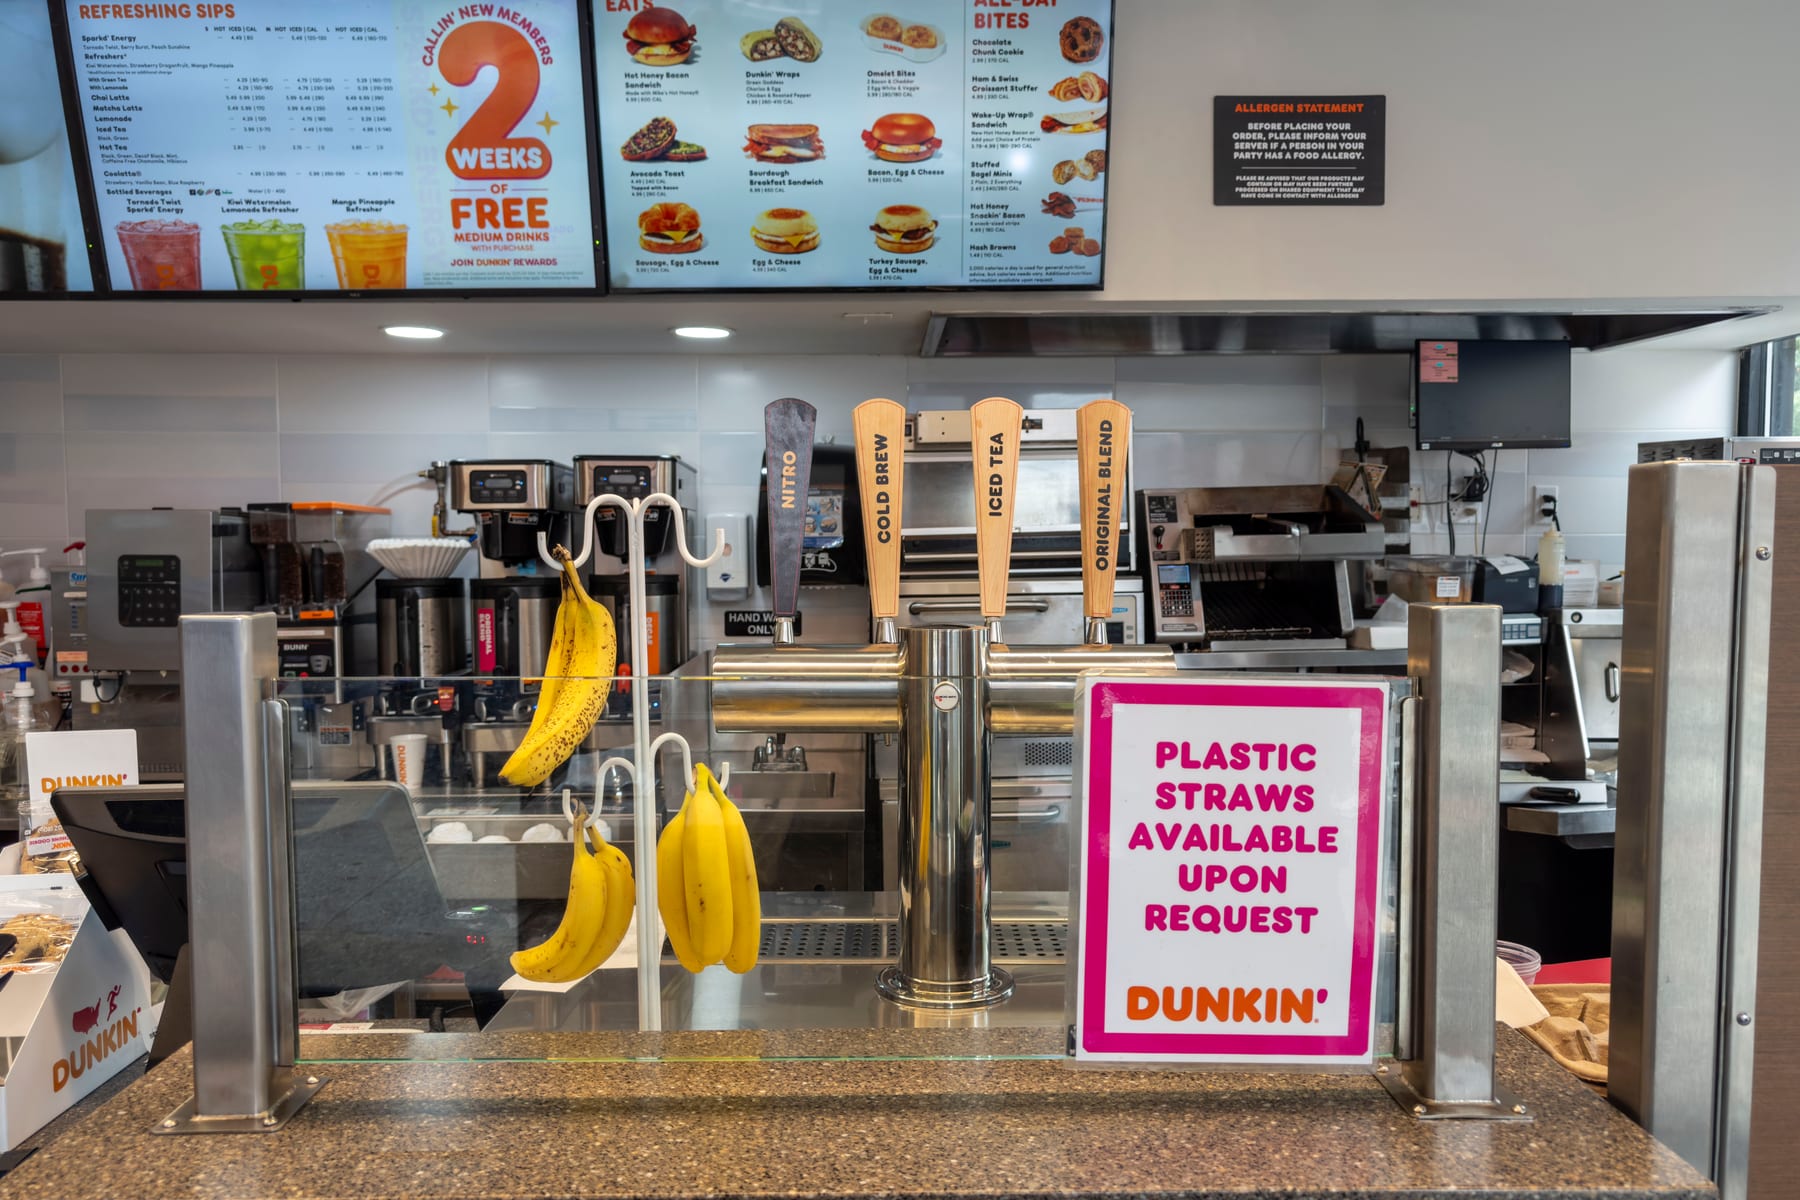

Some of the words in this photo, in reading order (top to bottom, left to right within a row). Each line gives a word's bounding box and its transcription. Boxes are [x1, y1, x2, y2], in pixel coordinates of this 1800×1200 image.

[79, 4, 191, 19] REFRESHING
[196, 4, 235, 18] SIPS
[975, 12, 1029, 29] BITES
[422, 12, 455, 67] CALLIN'
[458, 4, 495, 20] NEW
[497, 6, 553, 66] MEMBERS
[640, 72, 664, 80] Honey
[438, 21, 552, 180] 2
[1235, 104, 1294, 112] ALLERGEN
[1297, 104, 1364, 112] STATEMENT
[1232, 132, 1266, 140] ORDER,
[1339, 142, 1364, 150] YOUR
[452, 147, 542, 169] WEEKS
[749, 170, 789, 178] Sourdough
[895, 169, 908, 177] Egg
[490, 184, 508, 194] OF
[451, 198, 549, 229] FREE
[454, 233, 503, 242] MEDIUM
[506, 232, 549, 241] DRINKS
[513, 258, 557, 266] REWARDS
[869, 267, 882, 275] Egg
[874, 433, 889, 486] BREW
[990, 432, 1004, 468] TEA
[1098, 419, 1113, 478] BLEND
[781, 450, 797, 509] NITRO
[989, 474, 1003, 517] ICED
[877, 491, 891, 544] COLD
[1096, 484, 1111, 571] ORIGINAL
[729, 612, 760, 623] HAND
[747, 625, 775, 635] ONLY
[283, 643, 309, 651] BUNN
[485, 613, 493, 656] ORIGINAL
[1156, 742, 1316, 771] PLASTIC
[41, 774, 127, 793] DUNKIN'
[1155, 782, 1314, 812] STRAWS
[1128, 822, 1338, 853] AVAILABLE
[1179, 864, 1287, 893] UPON
[1145, 904, 1318, 934] REQUEST
[1127, 986, 1329, 1024] DUNKIN'
[52, 1007, 142, 1093] DUNKIN'
